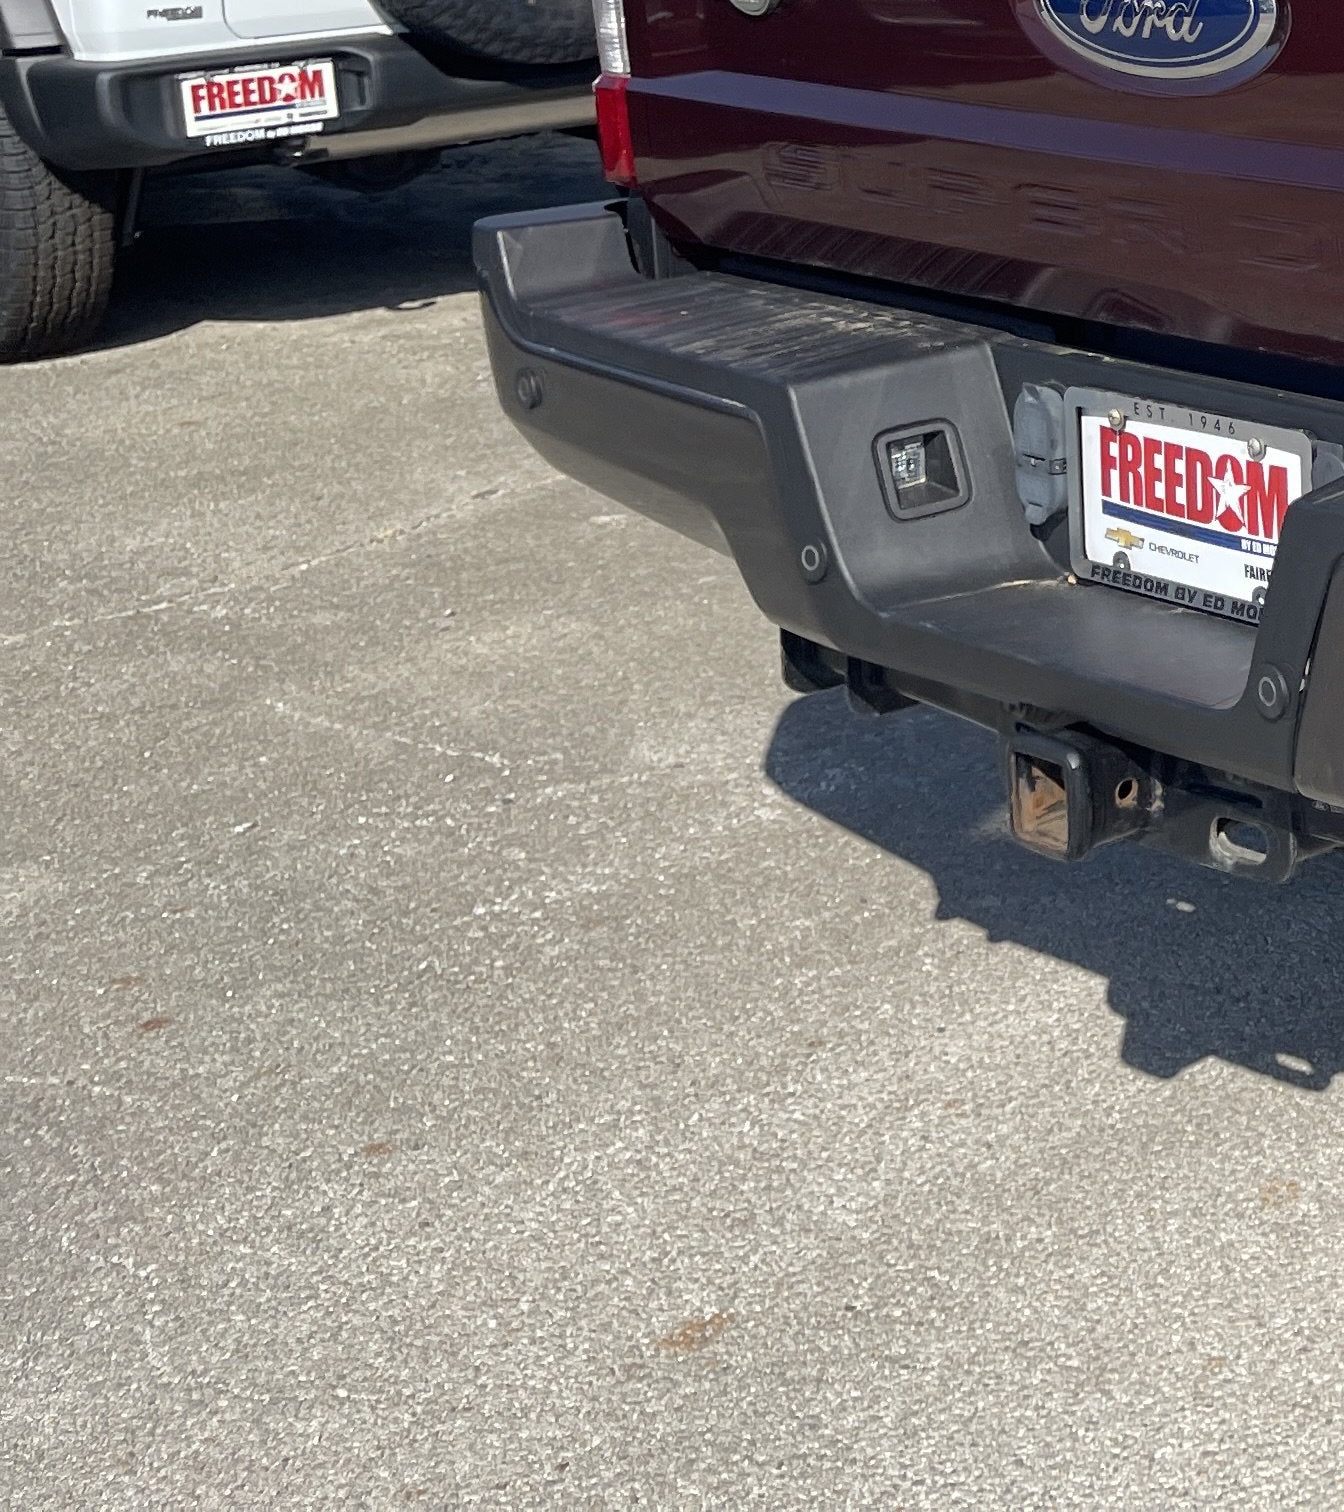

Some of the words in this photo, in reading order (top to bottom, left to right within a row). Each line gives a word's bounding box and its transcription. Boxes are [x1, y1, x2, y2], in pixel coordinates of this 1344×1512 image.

[190, 69, 326, 114] FREEDOM
[1188, 413, 1236, 435] 1946
[1099, 425, 1289, 539] FREEDOM
[1148, 542, 1200, 565] CHEVROLET
[1091, 564, 1170, 597] FREEDOM
[1174, 585, 1198, 604] BY
[1202, 593, 1225, 612] ED
[1230, 600, 1264, 621] MO
